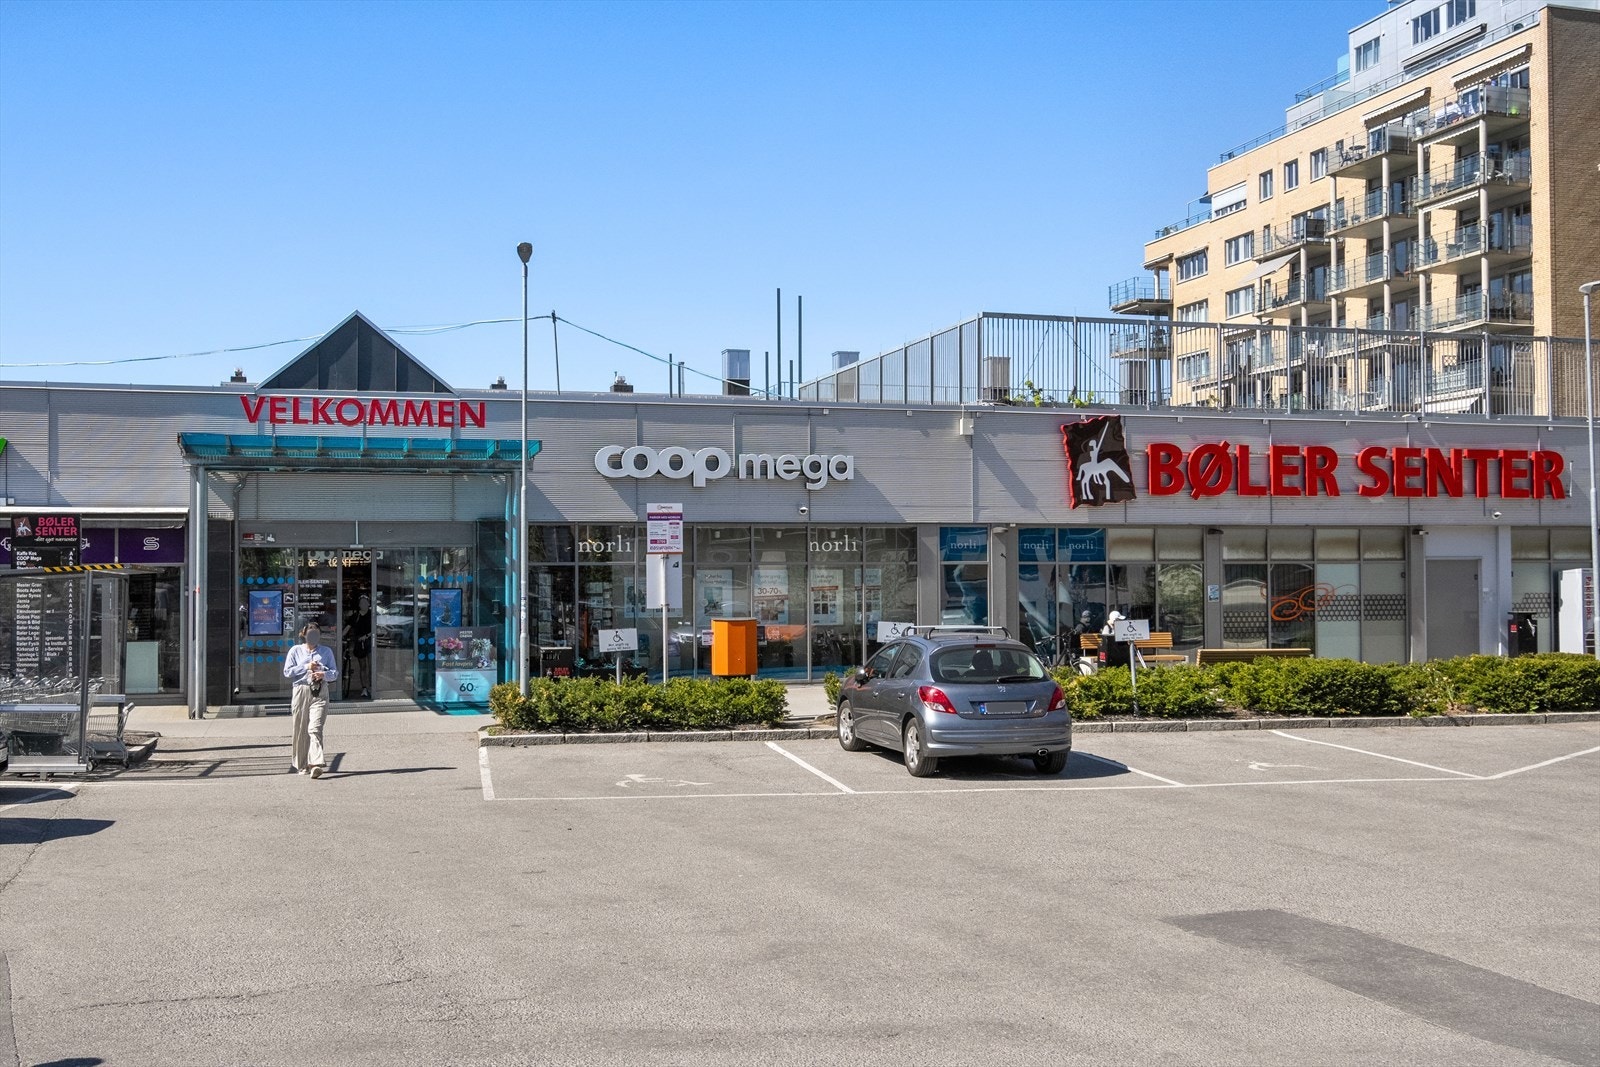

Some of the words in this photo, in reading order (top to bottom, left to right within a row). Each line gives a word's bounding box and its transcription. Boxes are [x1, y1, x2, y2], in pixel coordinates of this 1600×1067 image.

[240, 395, 487, 428] VELKOMMEN
[594, 444, 732, 488] coop
[738, 453, 855, 490] mega
[1147, 441, 1340, 500] BØLER
[1357, 446, 1566, 500] SENTER
[38, 517, 74, 526] BØLER
[35, 526, 78, 536] SENTER
[578, 534, 632, 553] norli
[810, 534, 858, 552] norli
[950, 539, 977, 550] norli
[1023, 539, 1050, 550] norli
[1068, 540, 1095, 550] norli
